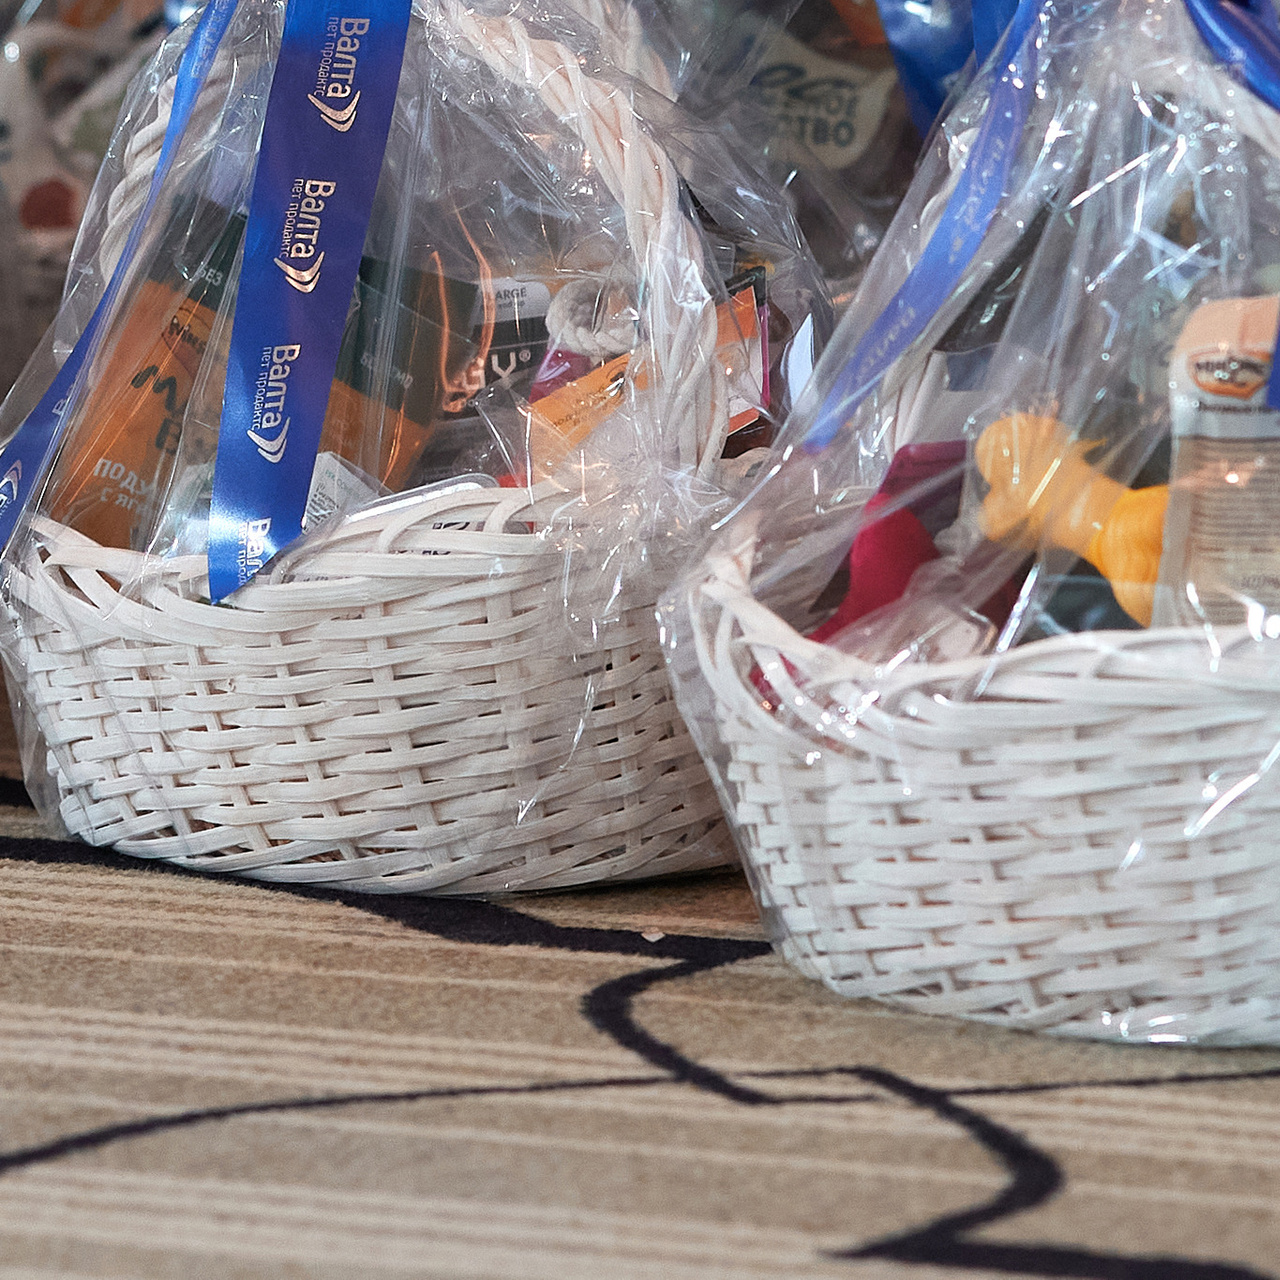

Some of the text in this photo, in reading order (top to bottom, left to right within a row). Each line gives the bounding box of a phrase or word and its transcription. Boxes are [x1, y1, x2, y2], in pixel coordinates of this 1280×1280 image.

[313, 16, 339, 96] пет продактс
[326, 17, 371, 99] Валта
[278, 178, 304, 258] пет продактс
[289, 179, 337, 259] Валта
[251, 346, 273, 431] пет продактс
[261, 344, 302, 429] Валта
[246, 517, 272, 577] Вал
